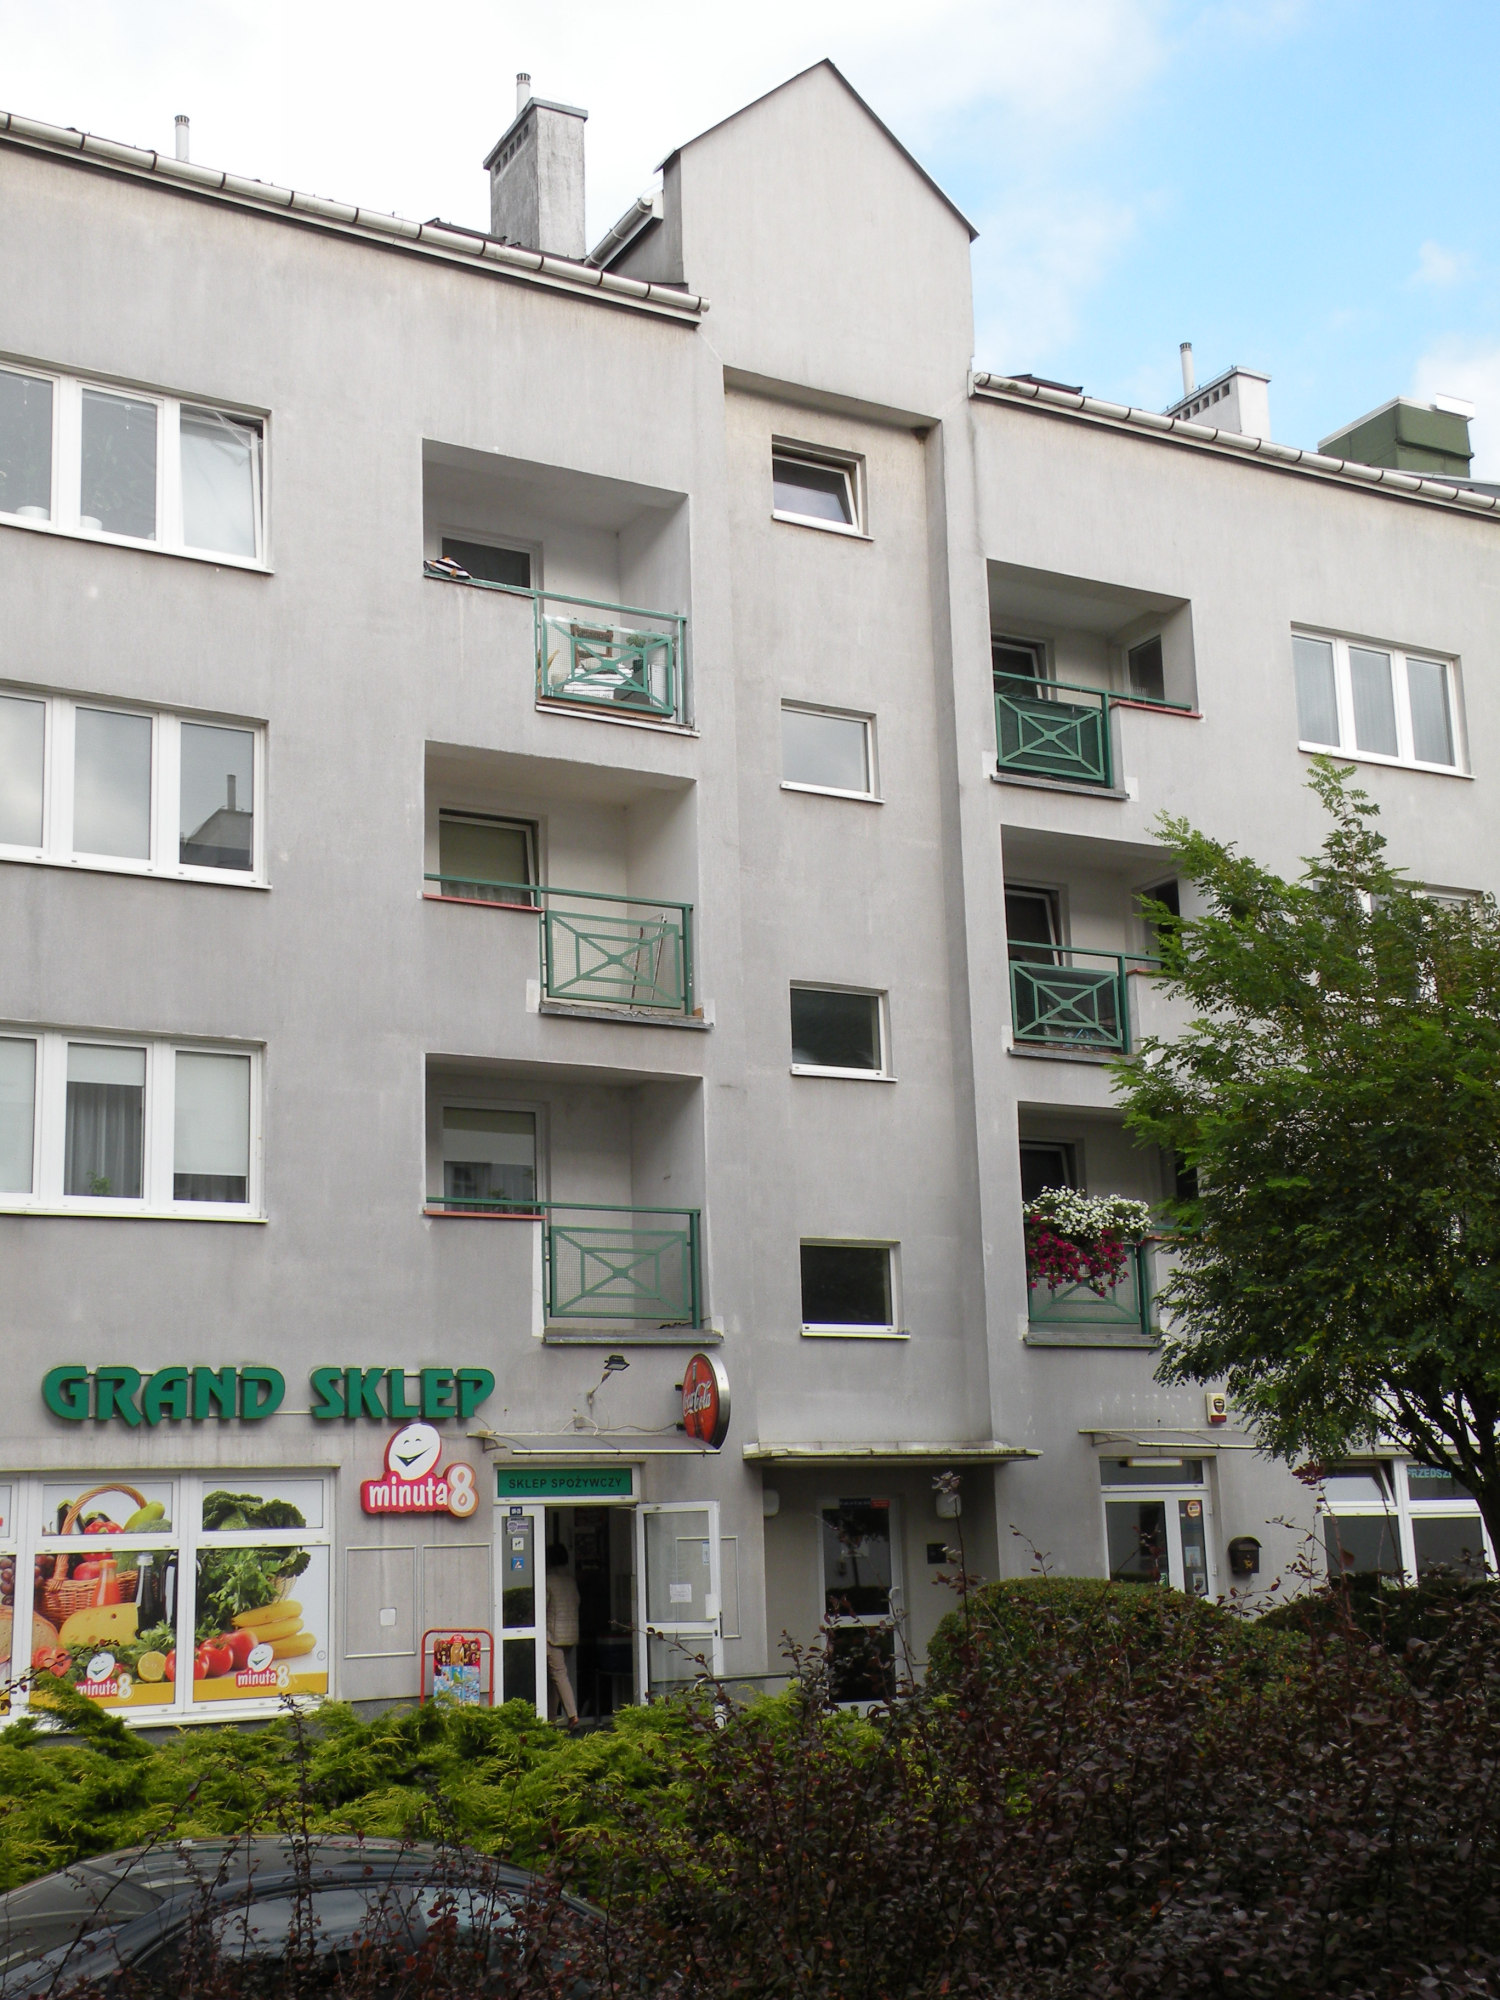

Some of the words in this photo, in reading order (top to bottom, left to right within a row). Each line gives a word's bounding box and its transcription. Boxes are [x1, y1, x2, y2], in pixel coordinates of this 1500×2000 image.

[42, 1365, 286, 1427] GRAND
[310, 1367, 496, 1419] SKLEP
[508, 1478, 548, 1489] SKLEP
[551, 1475, 622, 1488] SPOŻYWCZY
[1407, 1467, 1453, 1479] PRZEDSZ
[368, 1475, 448, 1508] minuta
